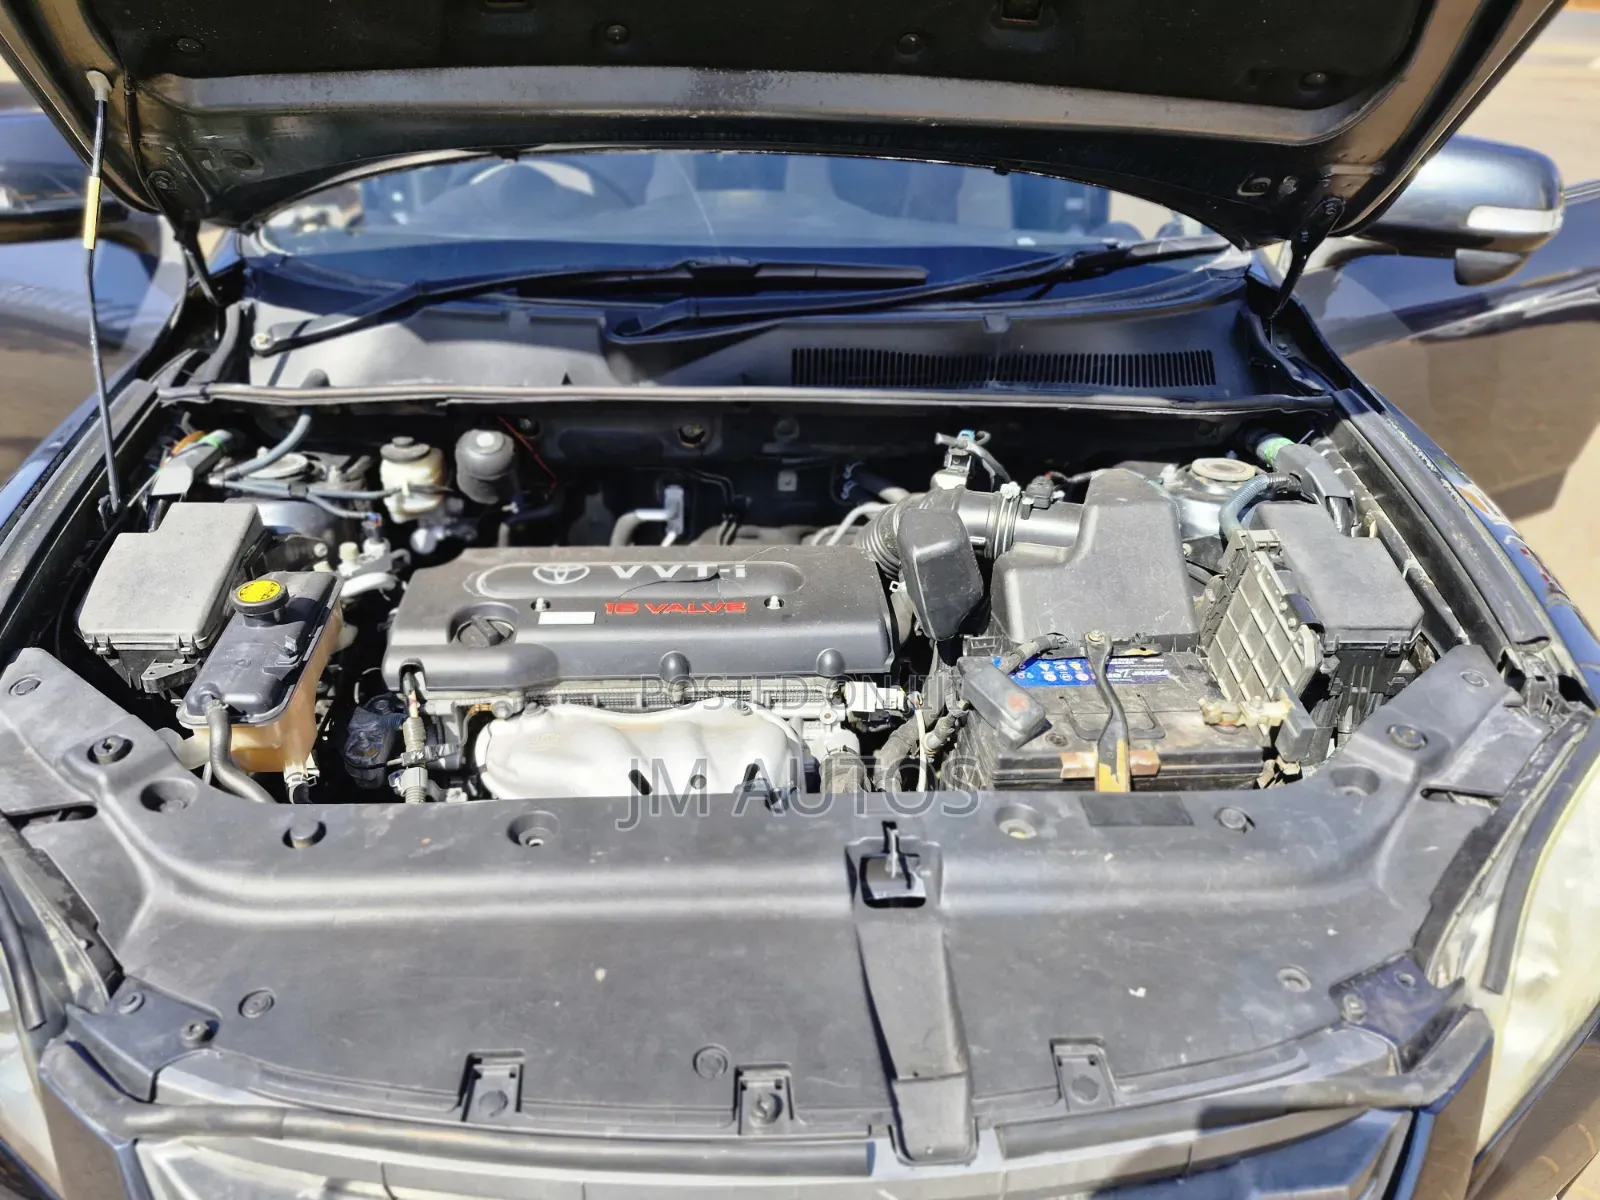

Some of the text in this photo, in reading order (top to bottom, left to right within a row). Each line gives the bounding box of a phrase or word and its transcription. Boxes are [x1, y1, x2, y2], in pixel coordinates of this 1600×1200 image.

[610, 564, 746, 579] VVT-i
[604, 601, 747, 615] 16 VALVE
